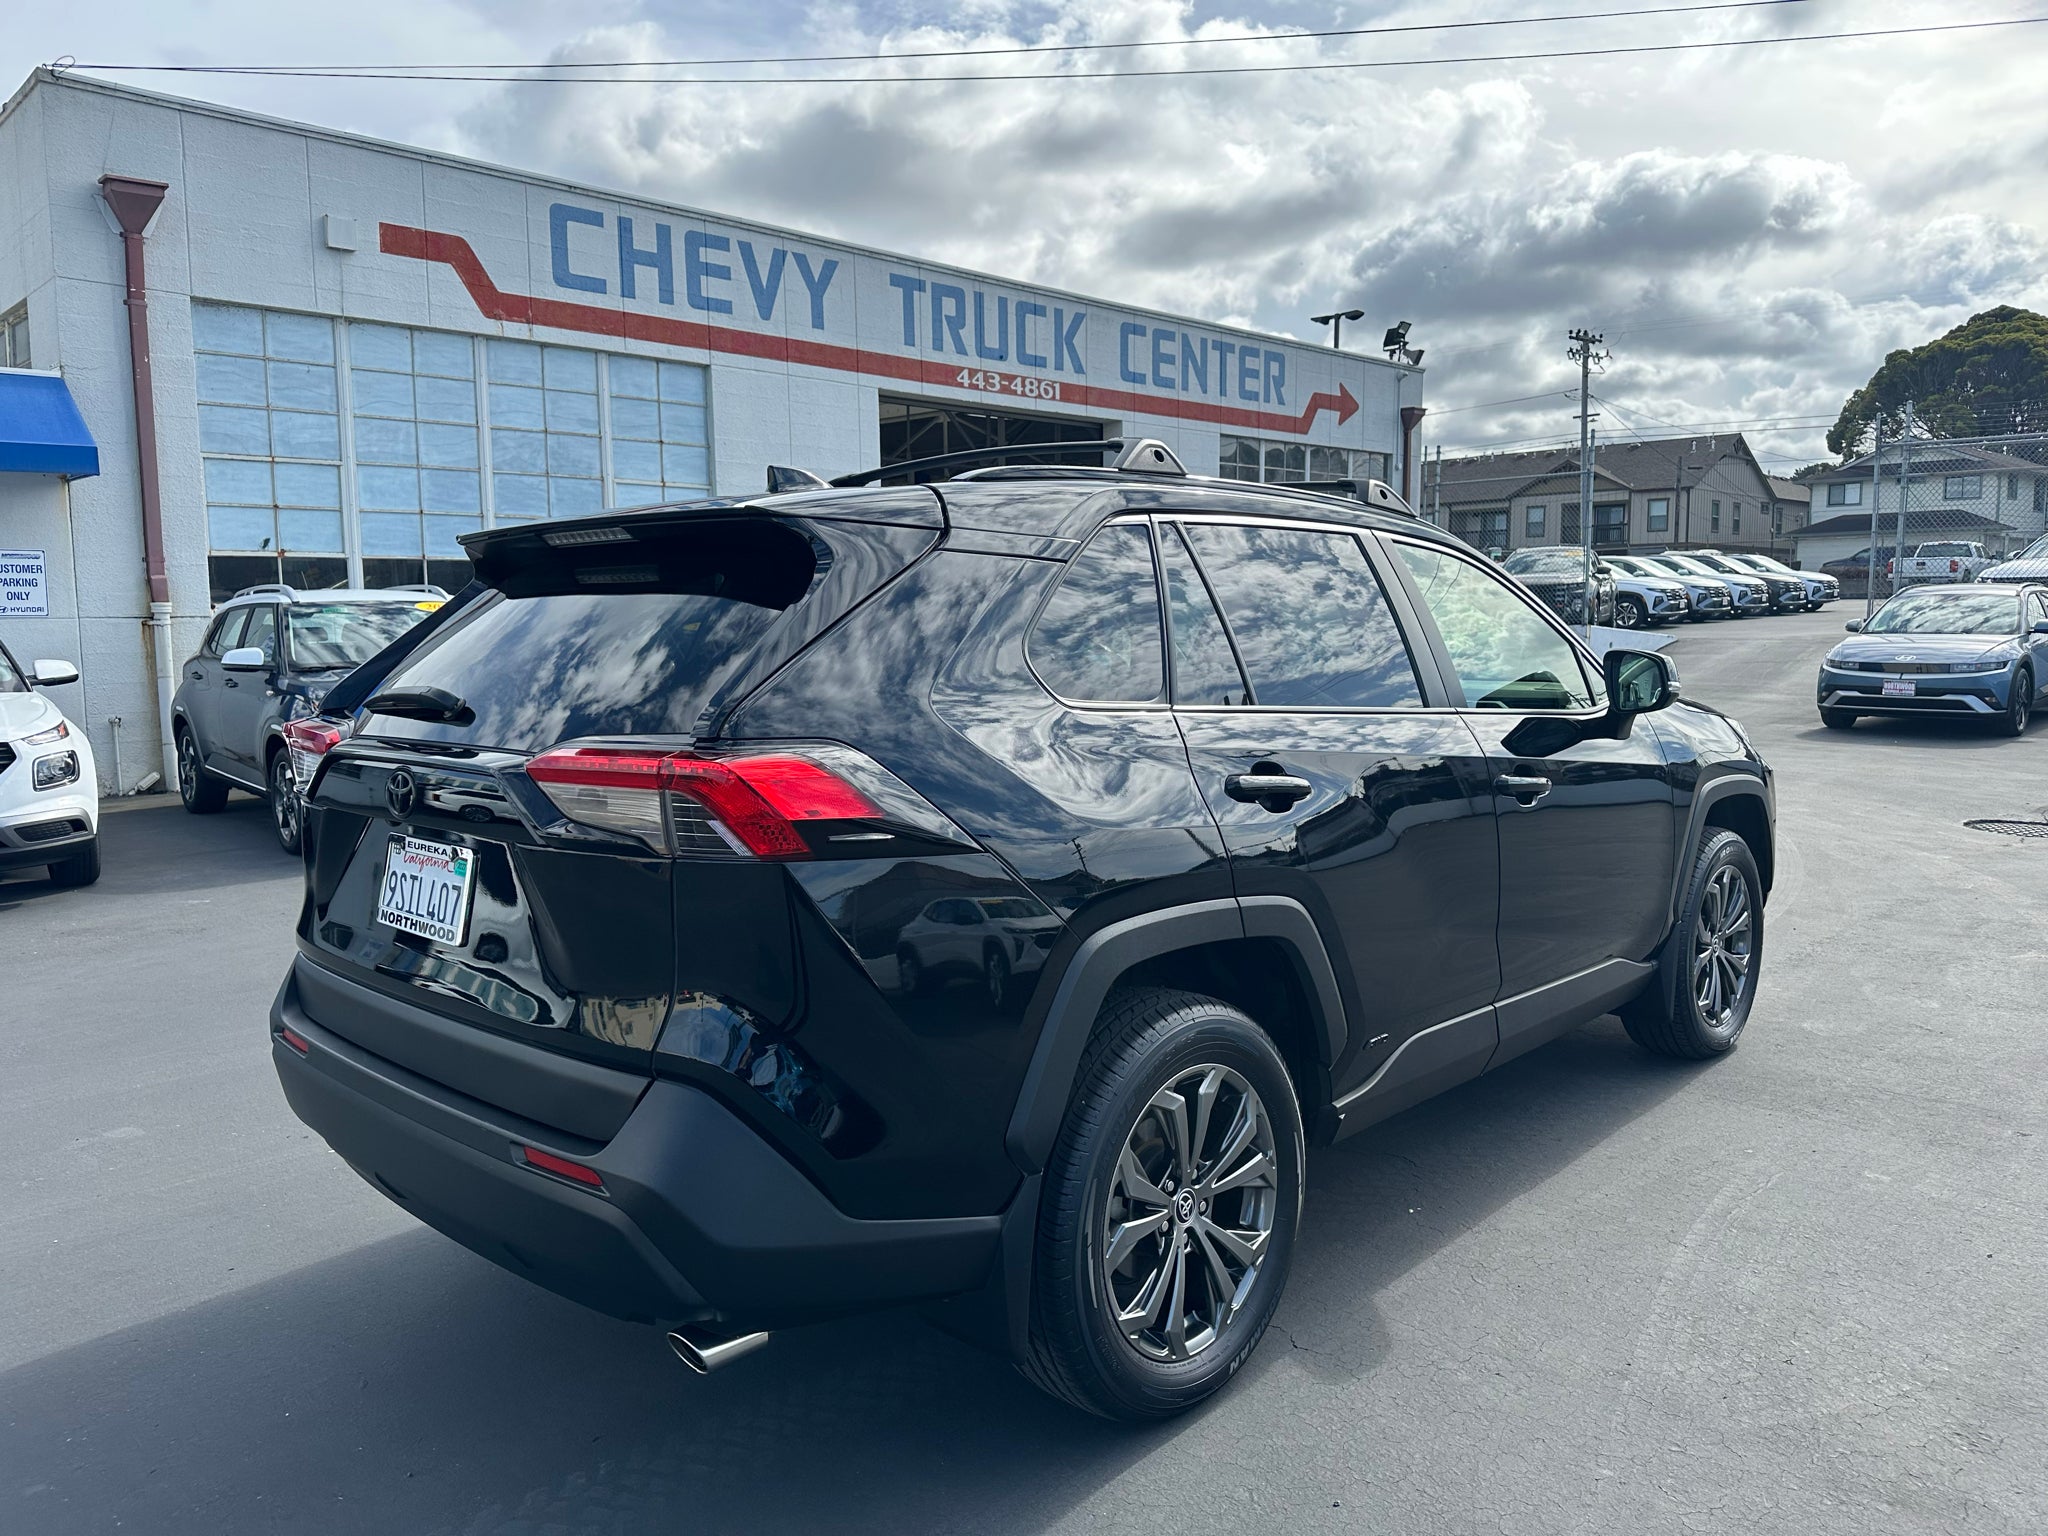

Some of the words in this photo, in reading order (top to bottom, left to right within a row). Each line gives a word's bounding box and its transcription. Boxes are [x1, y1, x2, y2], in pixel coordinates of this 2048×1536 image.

[549, 202, 839, 331] CHEVY
[889, 272, 1087, 375] TRUCK
[1120, 321, 1287, 407] CENTER
[956, 368, 1061, 401] 443-4861
[0, 563, 43, 574] USTOMER
[6, 591, 30, 601] ONLY
[407, 840, 448, 857] EUREKA
[385, 870, 462, 926] 9SIL407
[380, 909, 455, 942] NORTHWOOD
